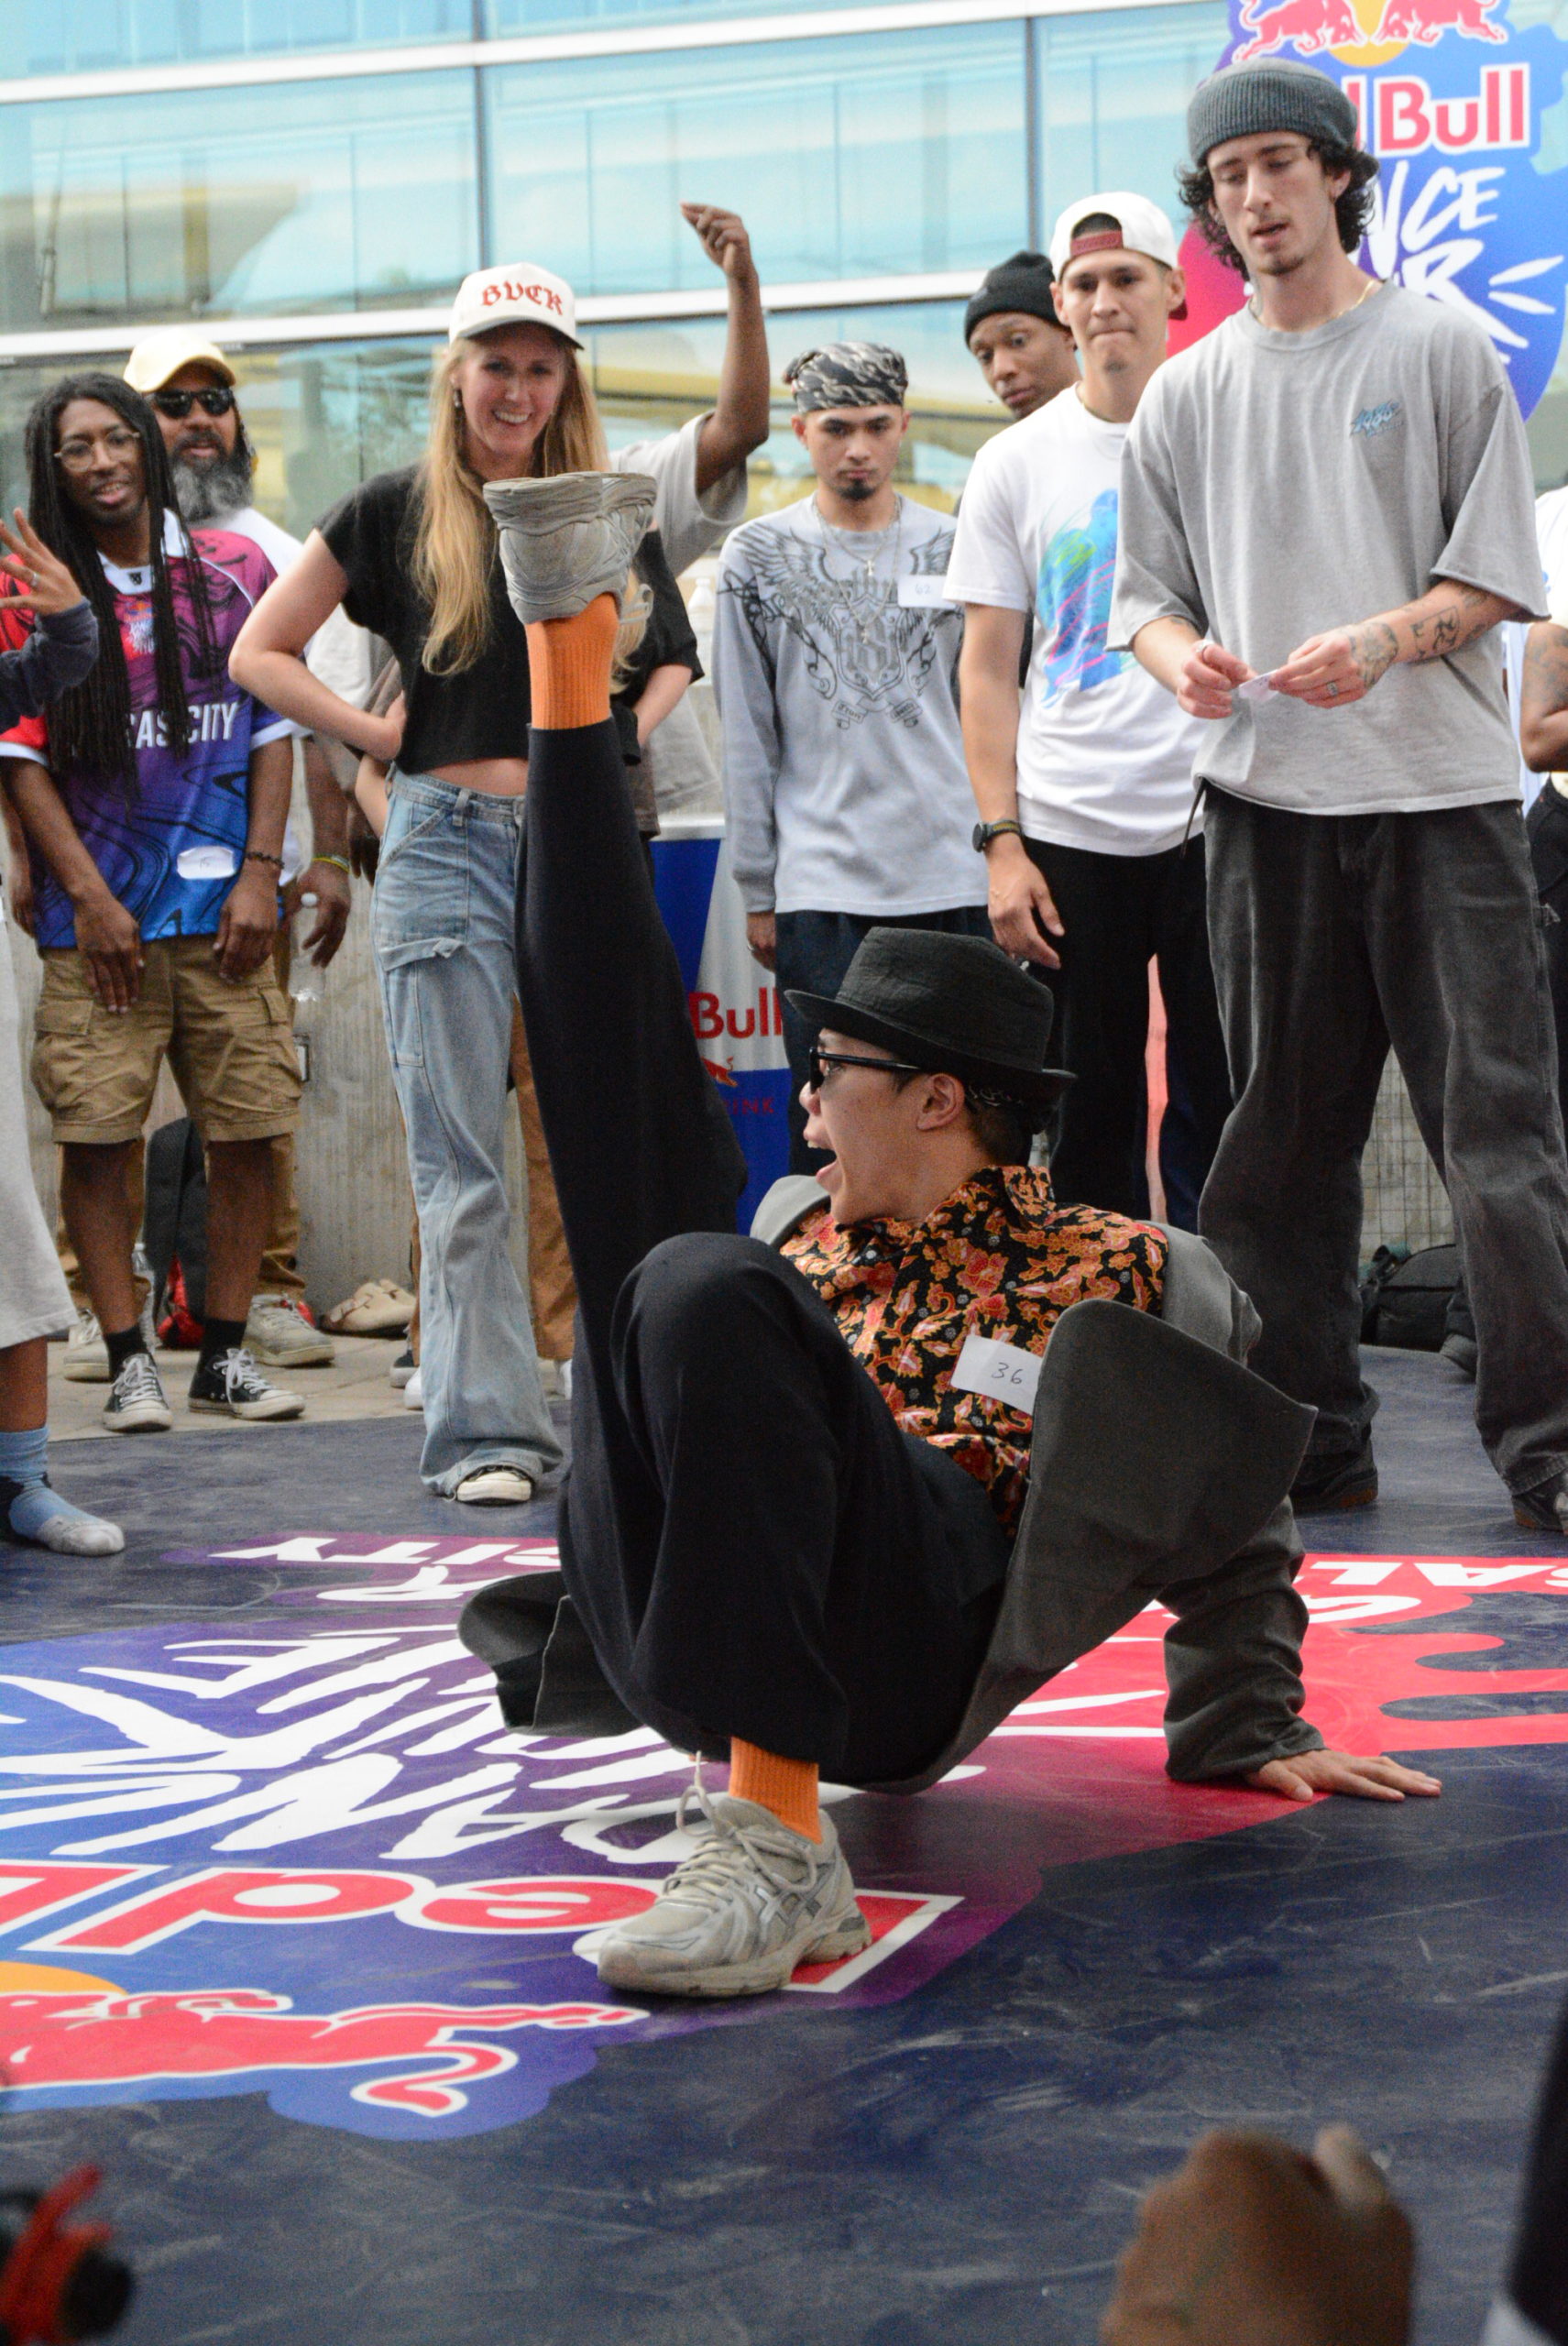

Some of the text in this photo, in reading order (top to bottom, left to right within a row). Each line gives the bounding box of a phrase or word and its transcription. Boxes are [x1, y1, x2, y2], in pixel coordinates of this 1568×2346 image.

[1376, 66, 1528, 152] Bull
[1365, 159, 1507, 280] NCE
[185, 701, 240, 744] CITY
[689, 987, 784, 1039] Bull
[722, 1096, 775, 1115] INK
[991, 1362, 1024, 1385] 36
